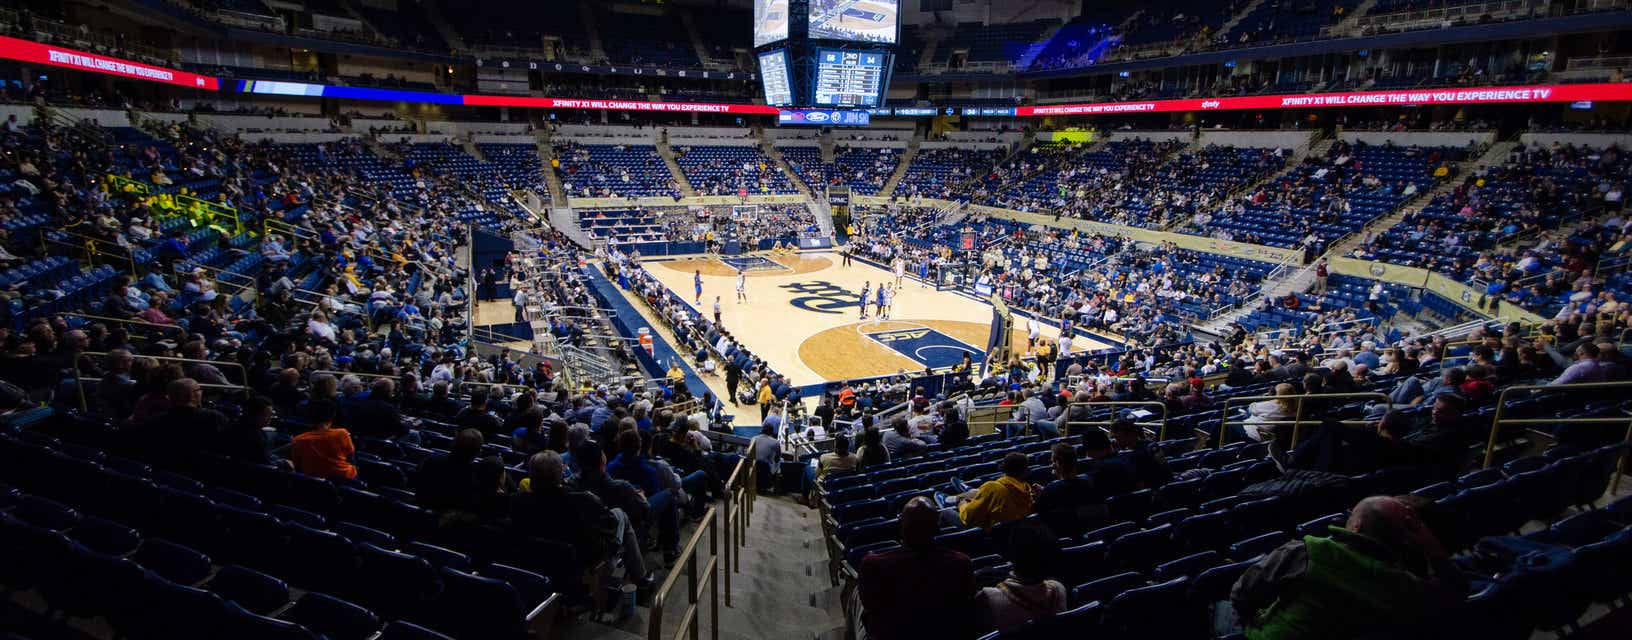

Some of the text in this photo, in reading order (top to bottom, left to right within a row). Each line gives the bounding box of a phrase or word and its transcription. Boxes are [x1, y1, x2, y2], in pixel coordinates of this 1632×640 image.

[1281, 89, 1550, 105] XFINITY X1 WILL CHANGE THE WAY YOU EXPERIENCE TV
[553, 100, 580, 108] XFINITY
[591, 101, 608, 109] WILL
[609, 102, 636, 110] CHANGE
[652, 103, 665, 111] WAY
[681, 104, 720, 112] EXPERIENCE
[1201, 101, 1219, 109] xfinity
[878, 330, 931, 341] ACC
